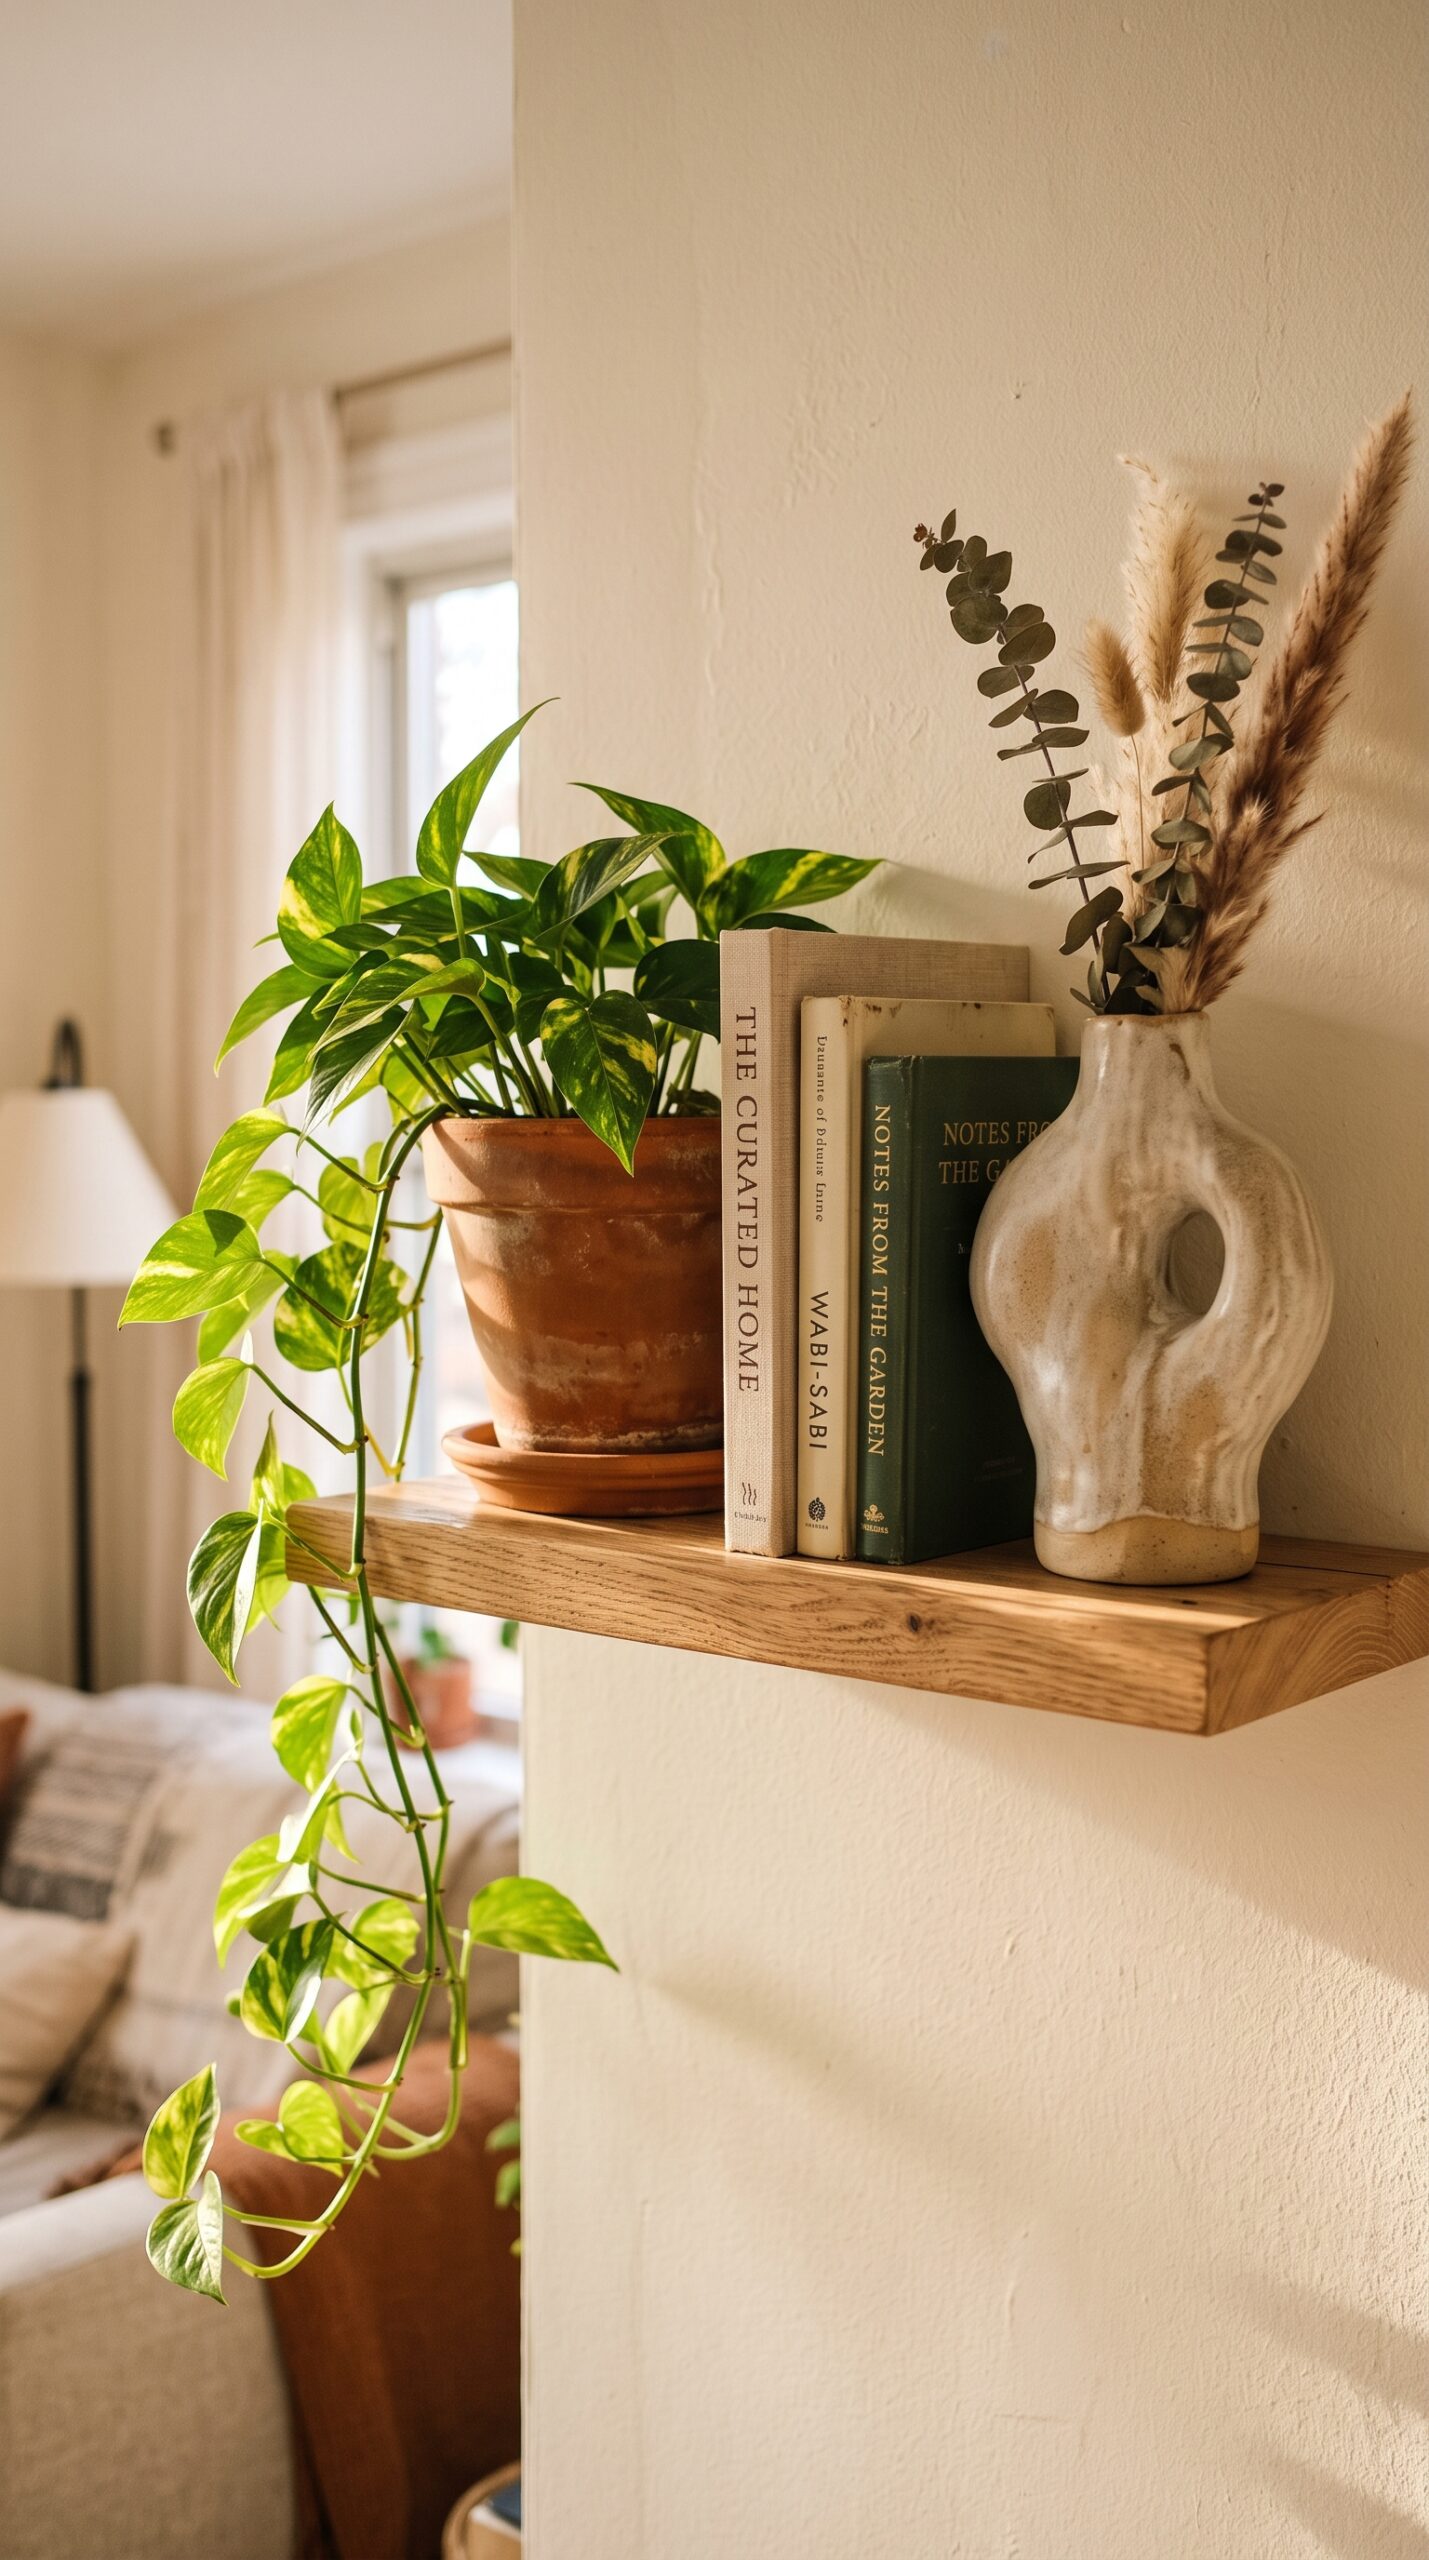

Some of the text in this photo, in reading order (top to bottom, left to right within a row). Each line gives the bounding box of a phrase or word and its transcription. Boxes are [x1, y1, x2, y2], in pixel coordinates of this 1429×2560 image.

[736, 1006, 760, 1392] THE CURATED HOME
[938, 1160, 979, 1185] THE
[943, 1121, 1010, 1146] NOTES
[867, 1104, 891, 1457] NOTES FROM THE GARDEN
[808, 1291, 829, 1449] WABI-SABI
